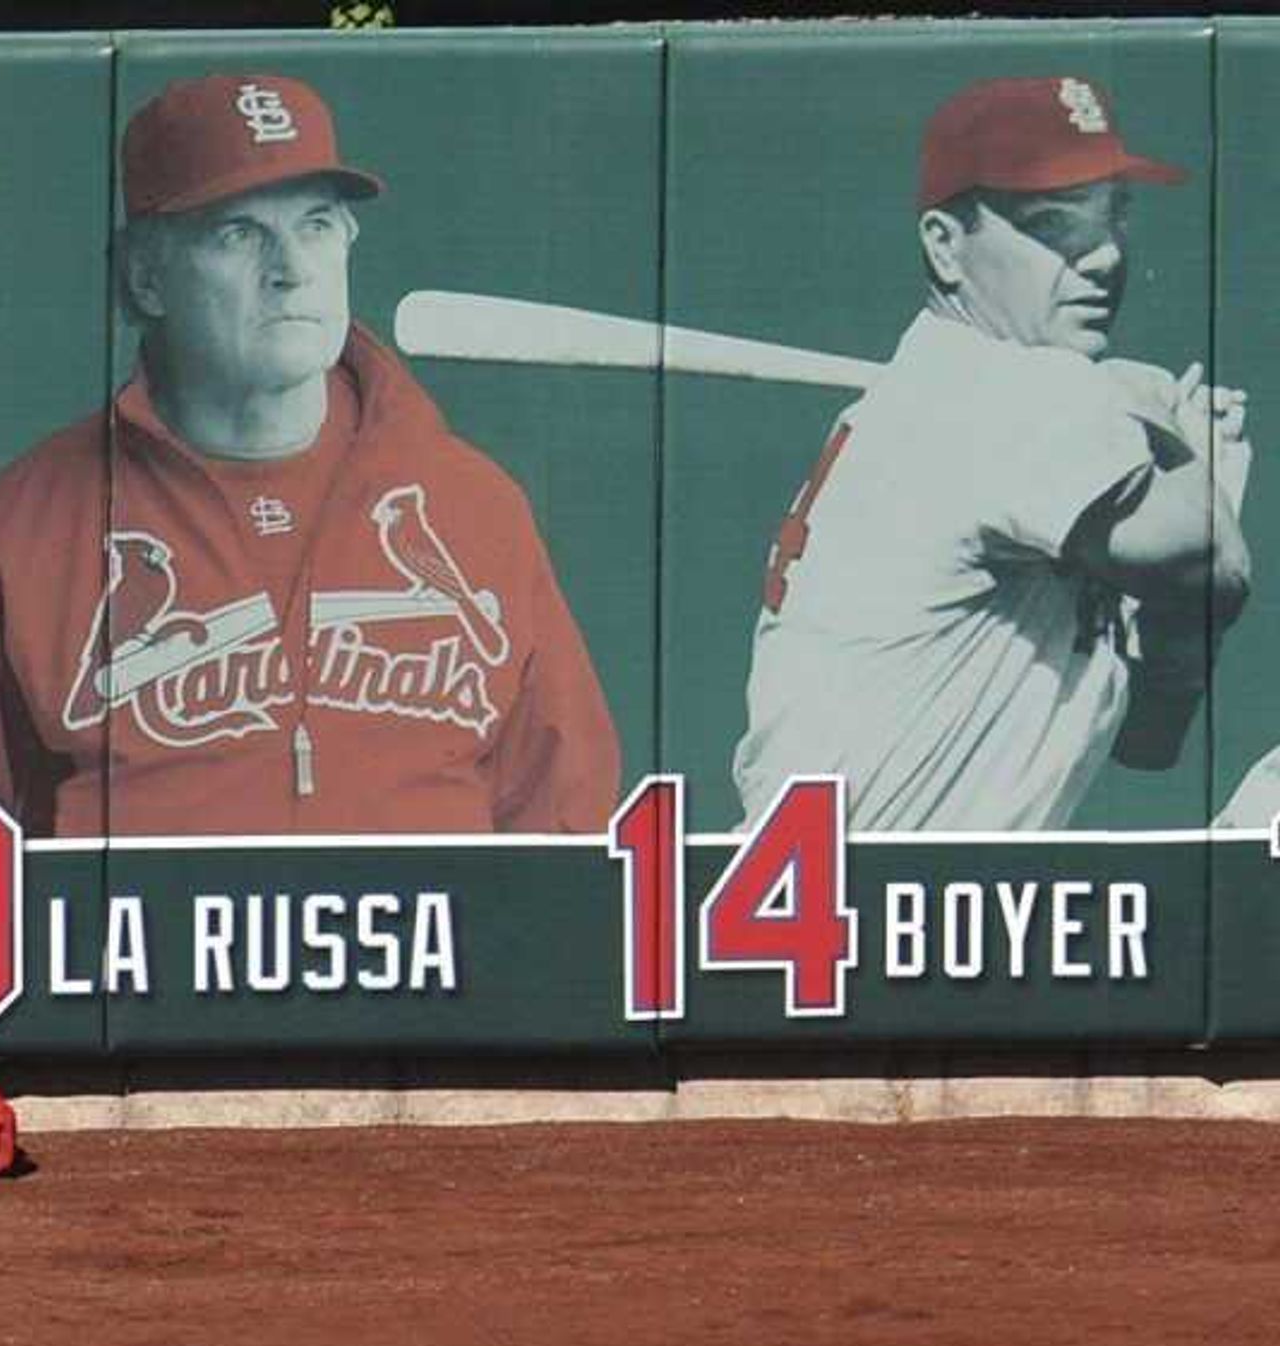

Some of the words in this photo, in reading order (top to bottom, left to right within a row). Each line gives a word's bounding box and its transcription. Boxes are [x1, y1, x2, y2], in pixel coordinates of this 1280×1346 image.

[49, 897, 149, 993] LA
[193, 892, 456, 992] RUSSA
[608, 773, 858, 1020] 14
[885, 881, 1149, 979] BOYER
